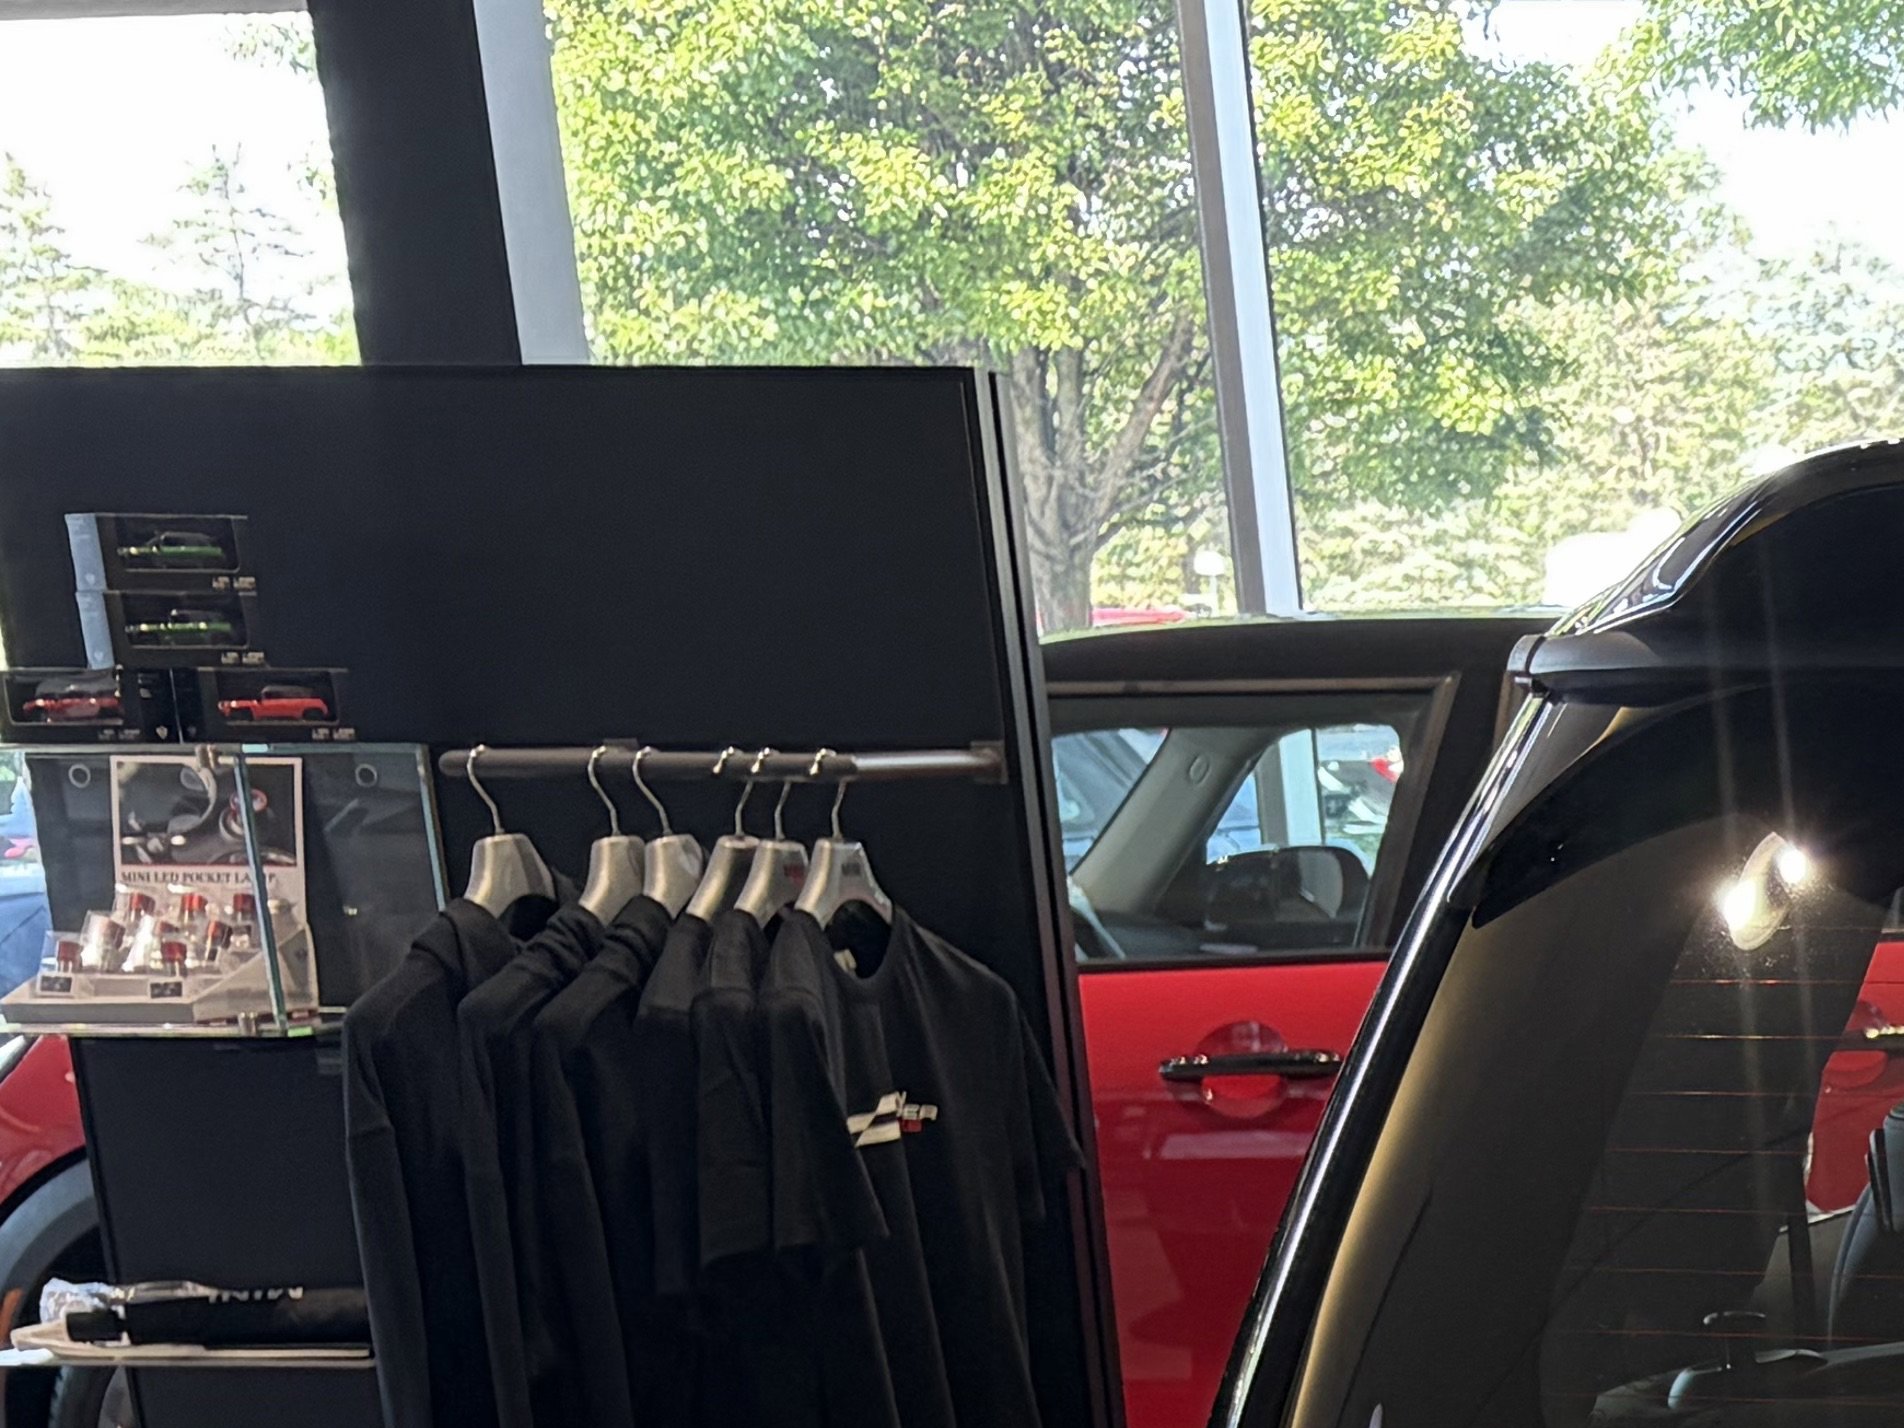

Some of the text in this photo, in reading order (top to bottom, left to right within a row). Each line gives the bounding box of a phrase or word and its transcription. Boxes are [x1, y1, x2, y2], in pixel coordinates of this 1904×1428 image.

[122, 871, 276, 884] MINI LED POCKET LAP
